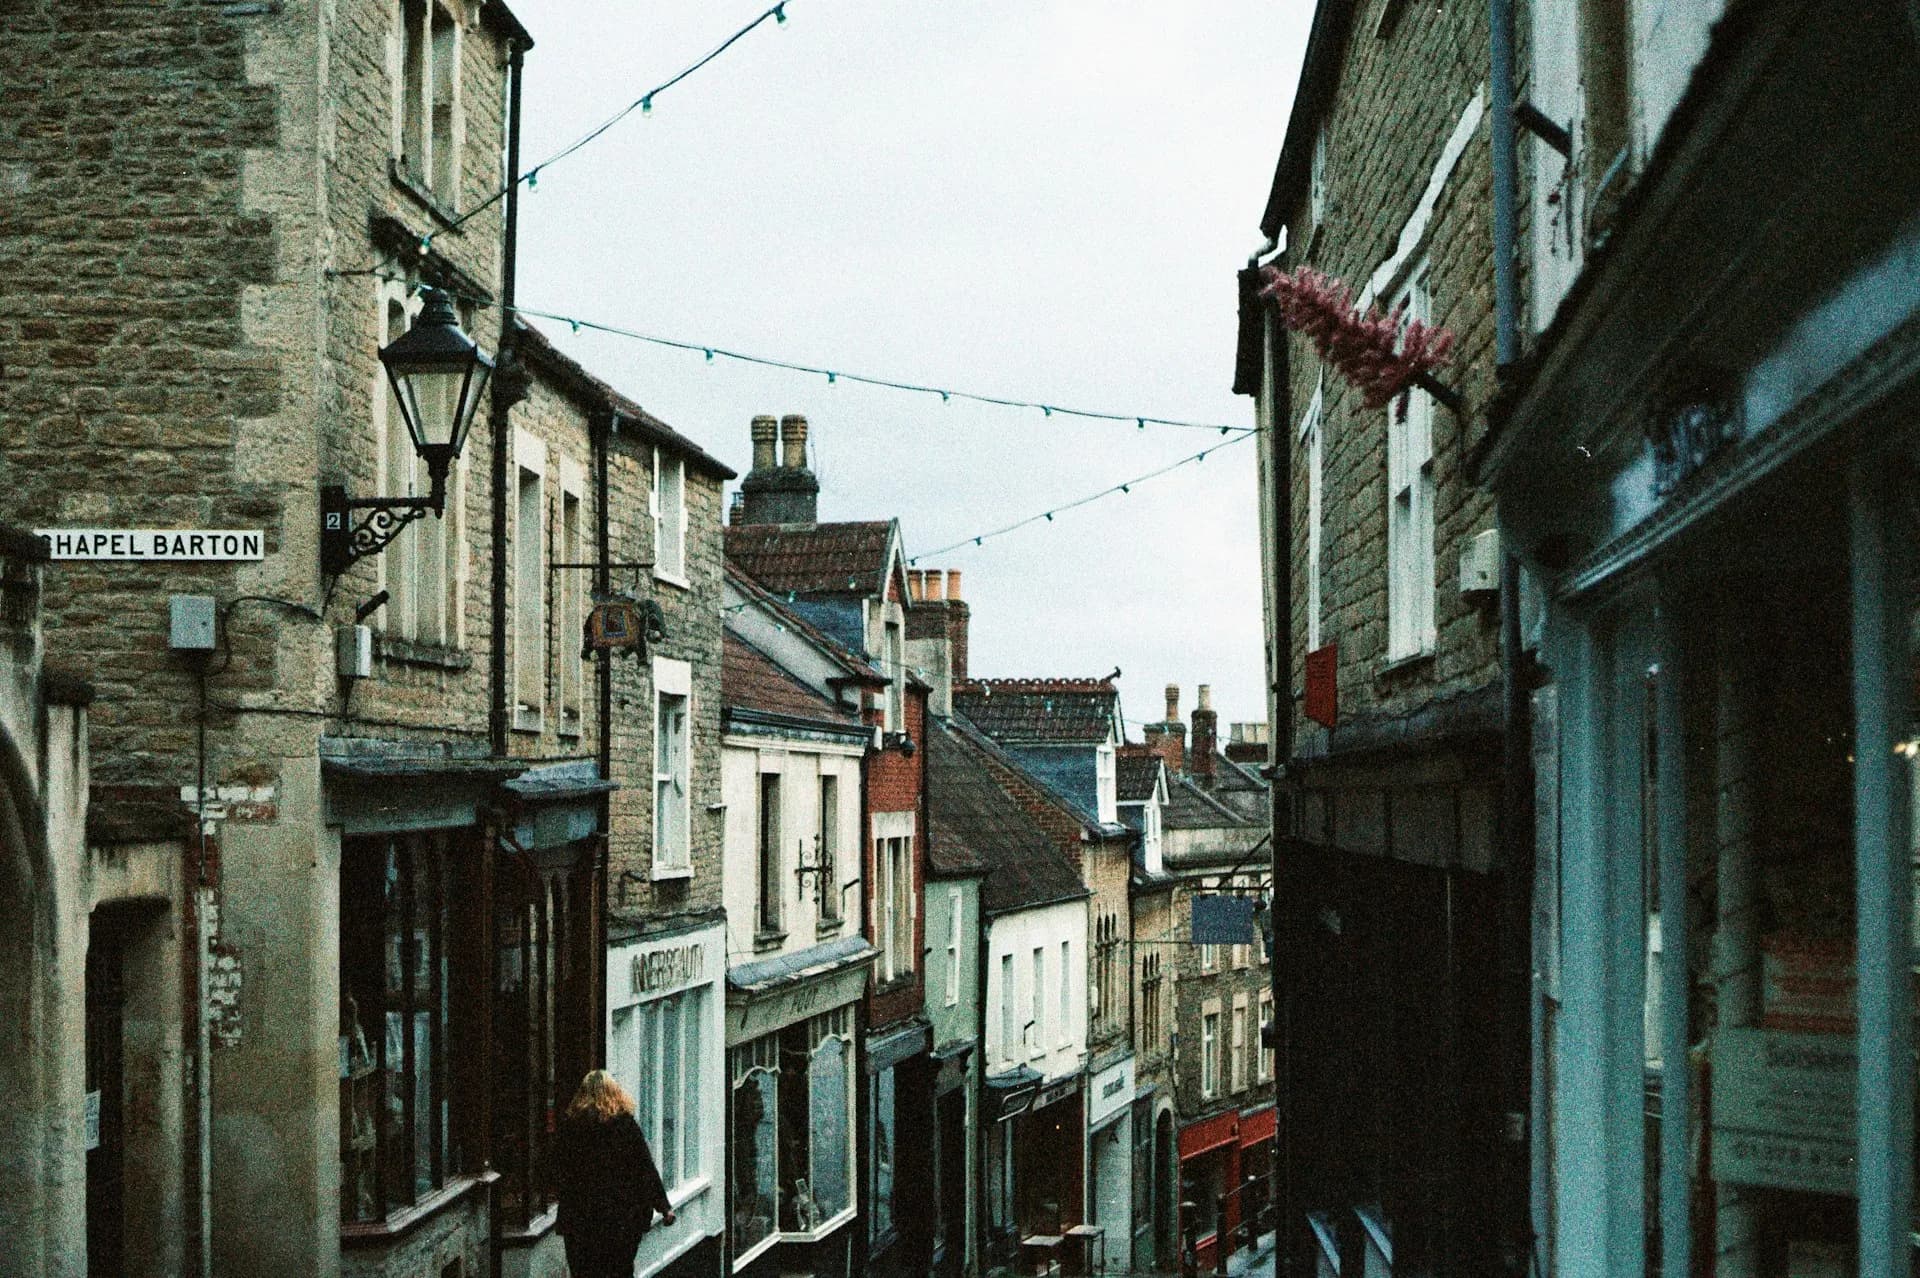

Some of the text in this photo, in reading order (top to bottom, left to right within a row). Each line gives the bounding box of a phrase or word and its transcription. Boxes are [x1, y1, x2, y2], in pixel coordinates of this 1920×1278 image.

[328, 514, 339, 528] 2
[40, 534, 259, 556] HAPEL BARTON
